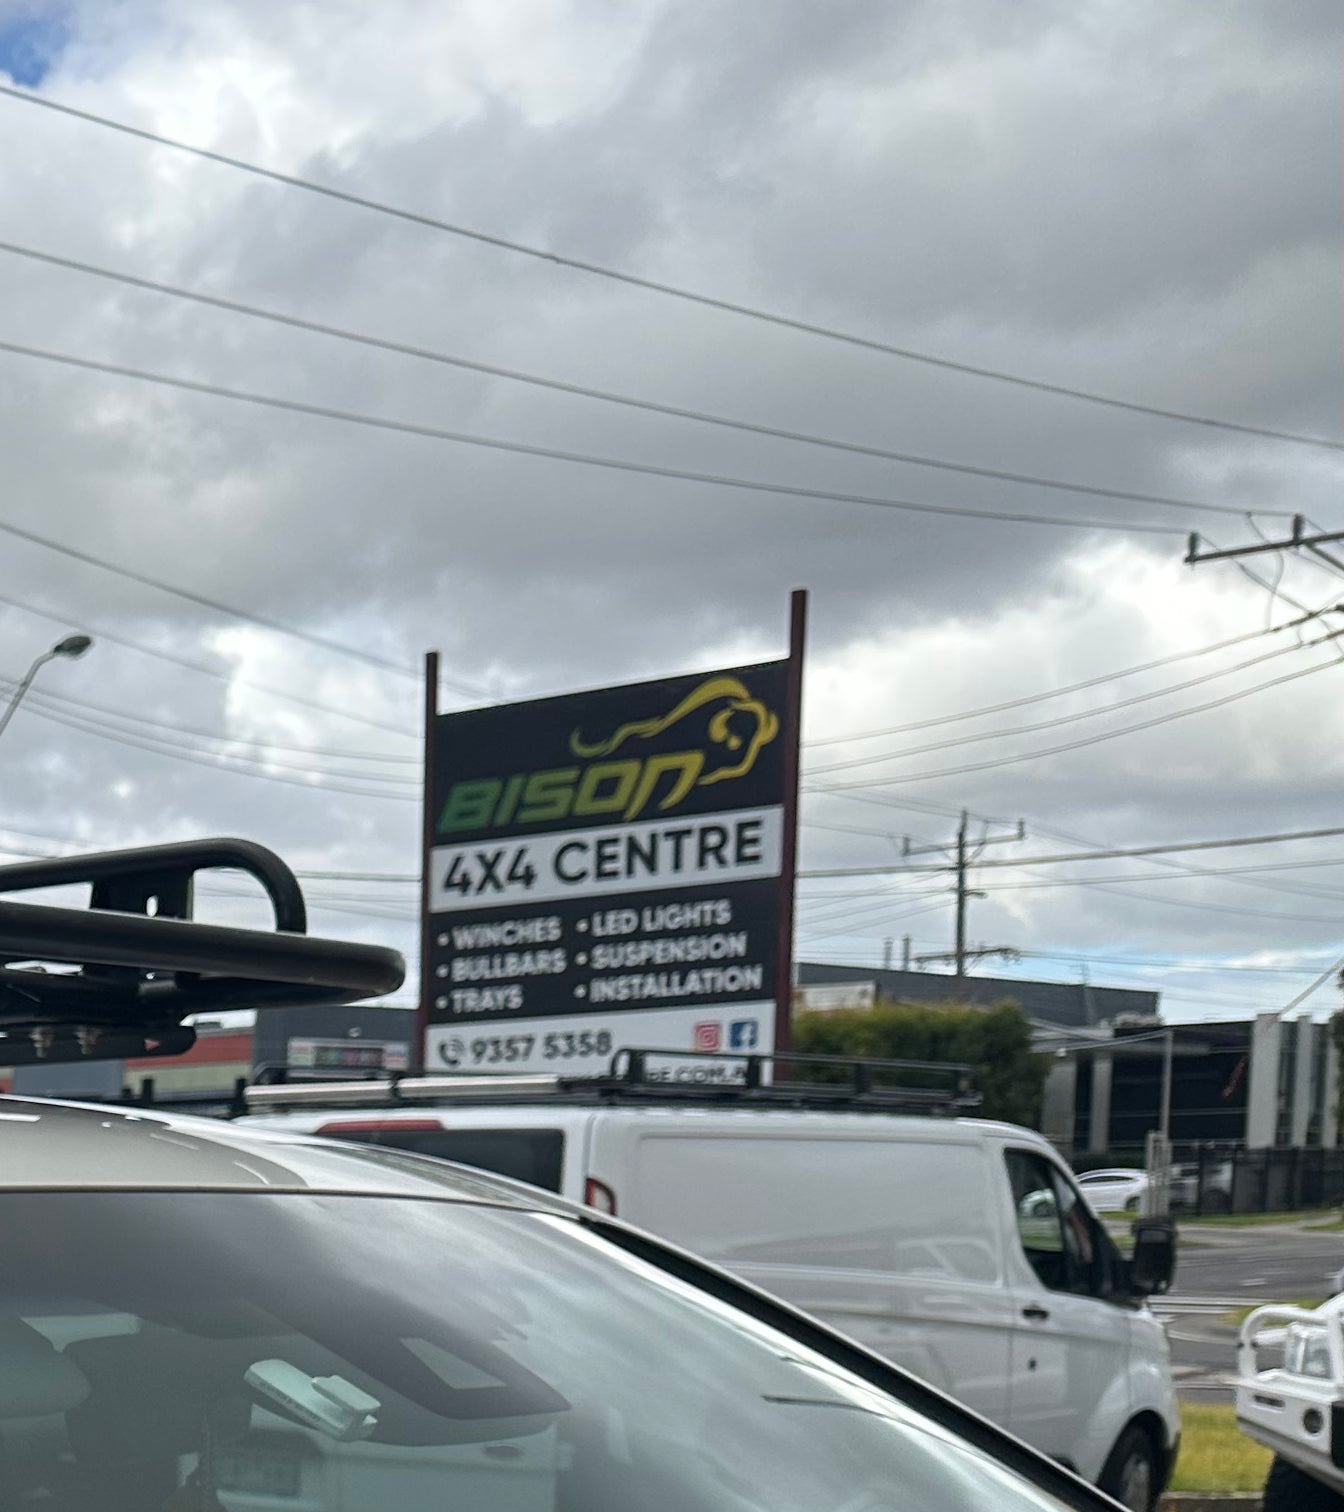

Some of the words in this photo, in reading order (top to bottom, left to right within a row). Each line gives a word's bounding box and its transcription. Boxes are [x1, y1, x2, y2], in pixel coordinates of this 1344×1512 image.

[442, 846, 537, 898] 4X4
[553, 818, 764, 885] CENTRE
[451, 916, 562, 950] WINCHES
[591, 908, 639, 937] LED
[642, 898, 732, 932] LIGHTS
[450, 948, 567, 982] BULLBARS
[590, 930, 748, 970] SUSPENSION
[450, 984, 524, 1014] TRAYS
[589, 963, 762, 1002] INSTALLATION
[470, 1033, 535, 1065] 9357
[543, 1028, 612, 1059] 5358
